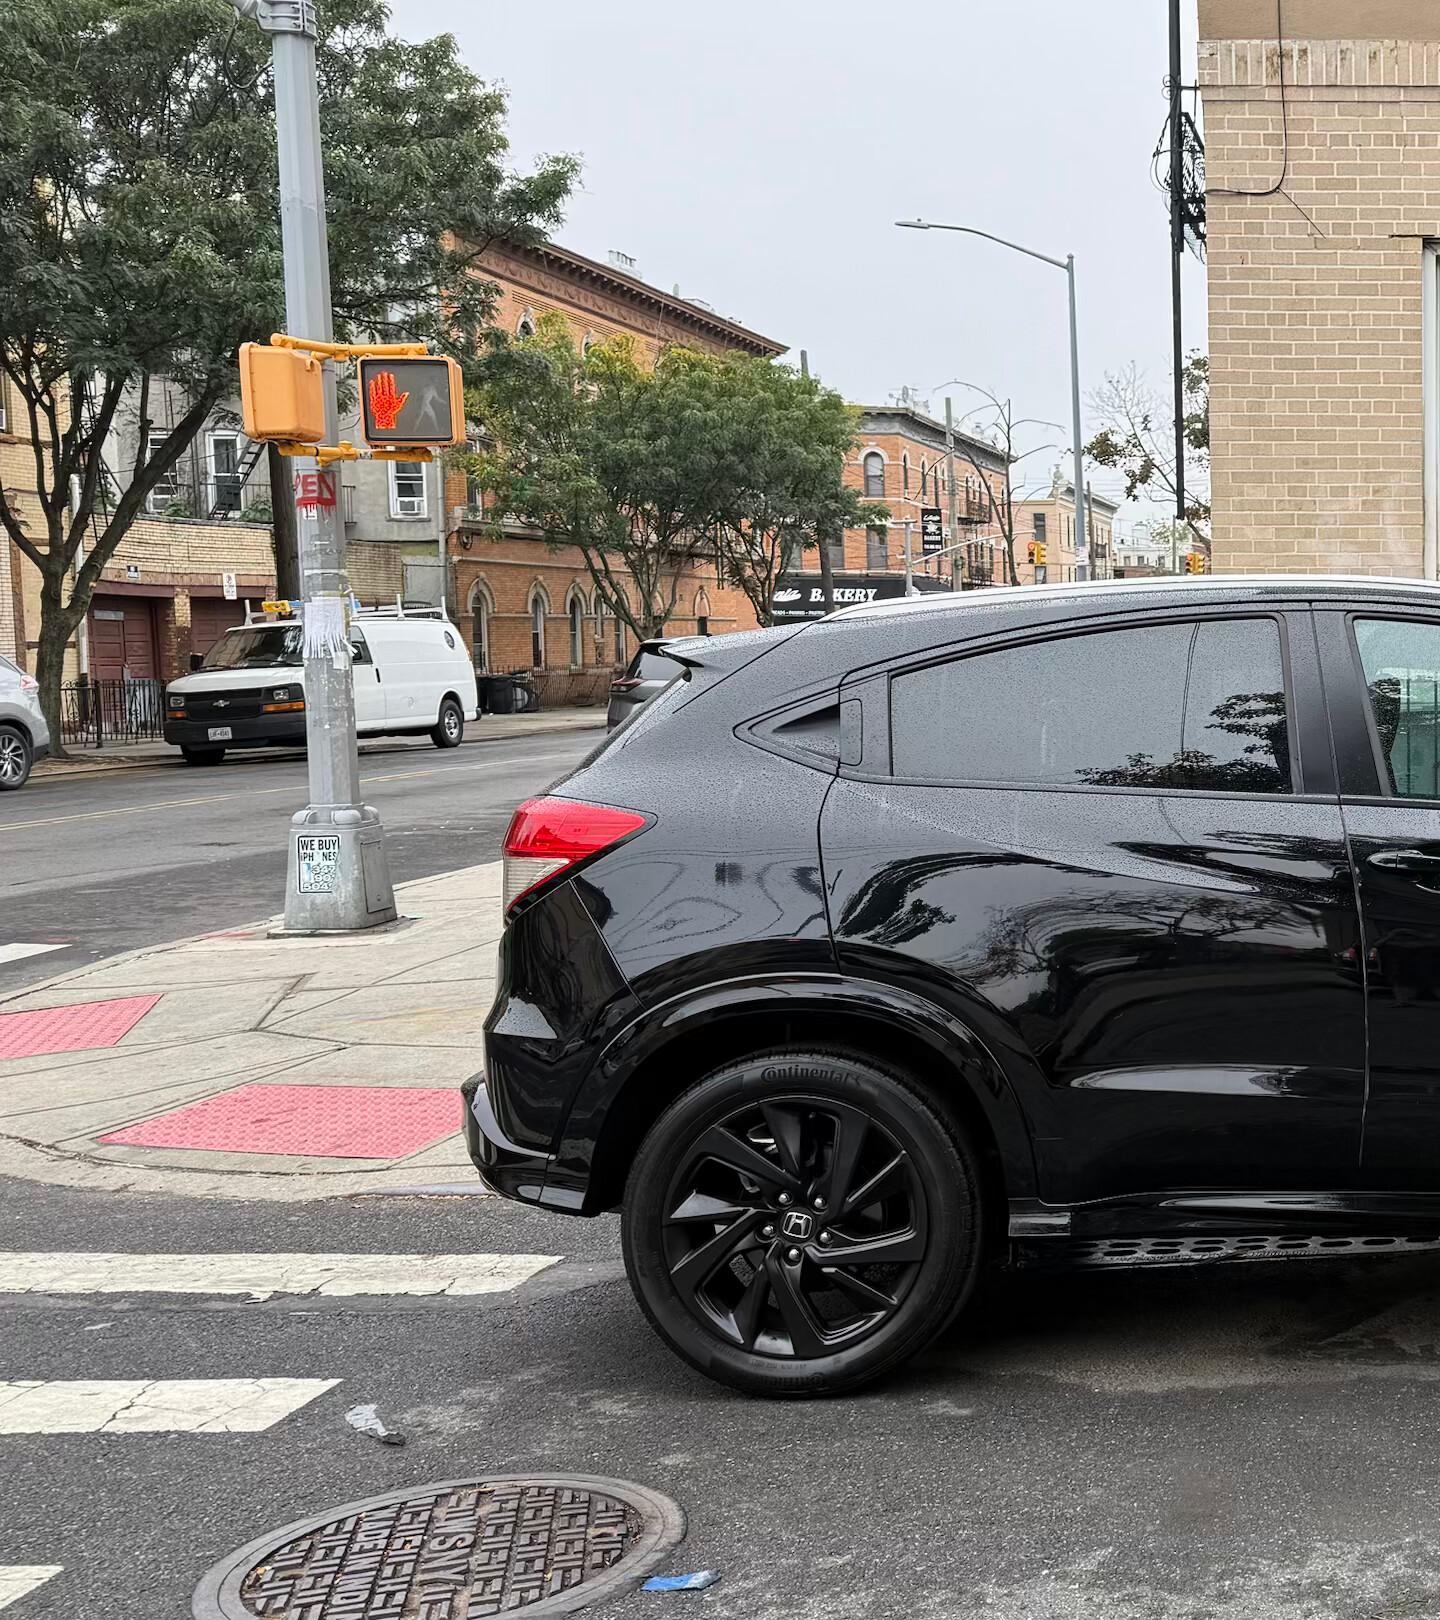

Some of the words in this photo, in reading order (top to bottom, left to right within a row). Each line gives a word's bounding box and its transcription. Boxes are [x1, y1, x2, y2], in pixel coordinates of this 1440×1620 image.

[809, 588, 878, 602] BKERY
[301, 839, 315, 851] WE
[318, 839, 337, 851] BUY
[760, 1064, 850, 1083] Continental
